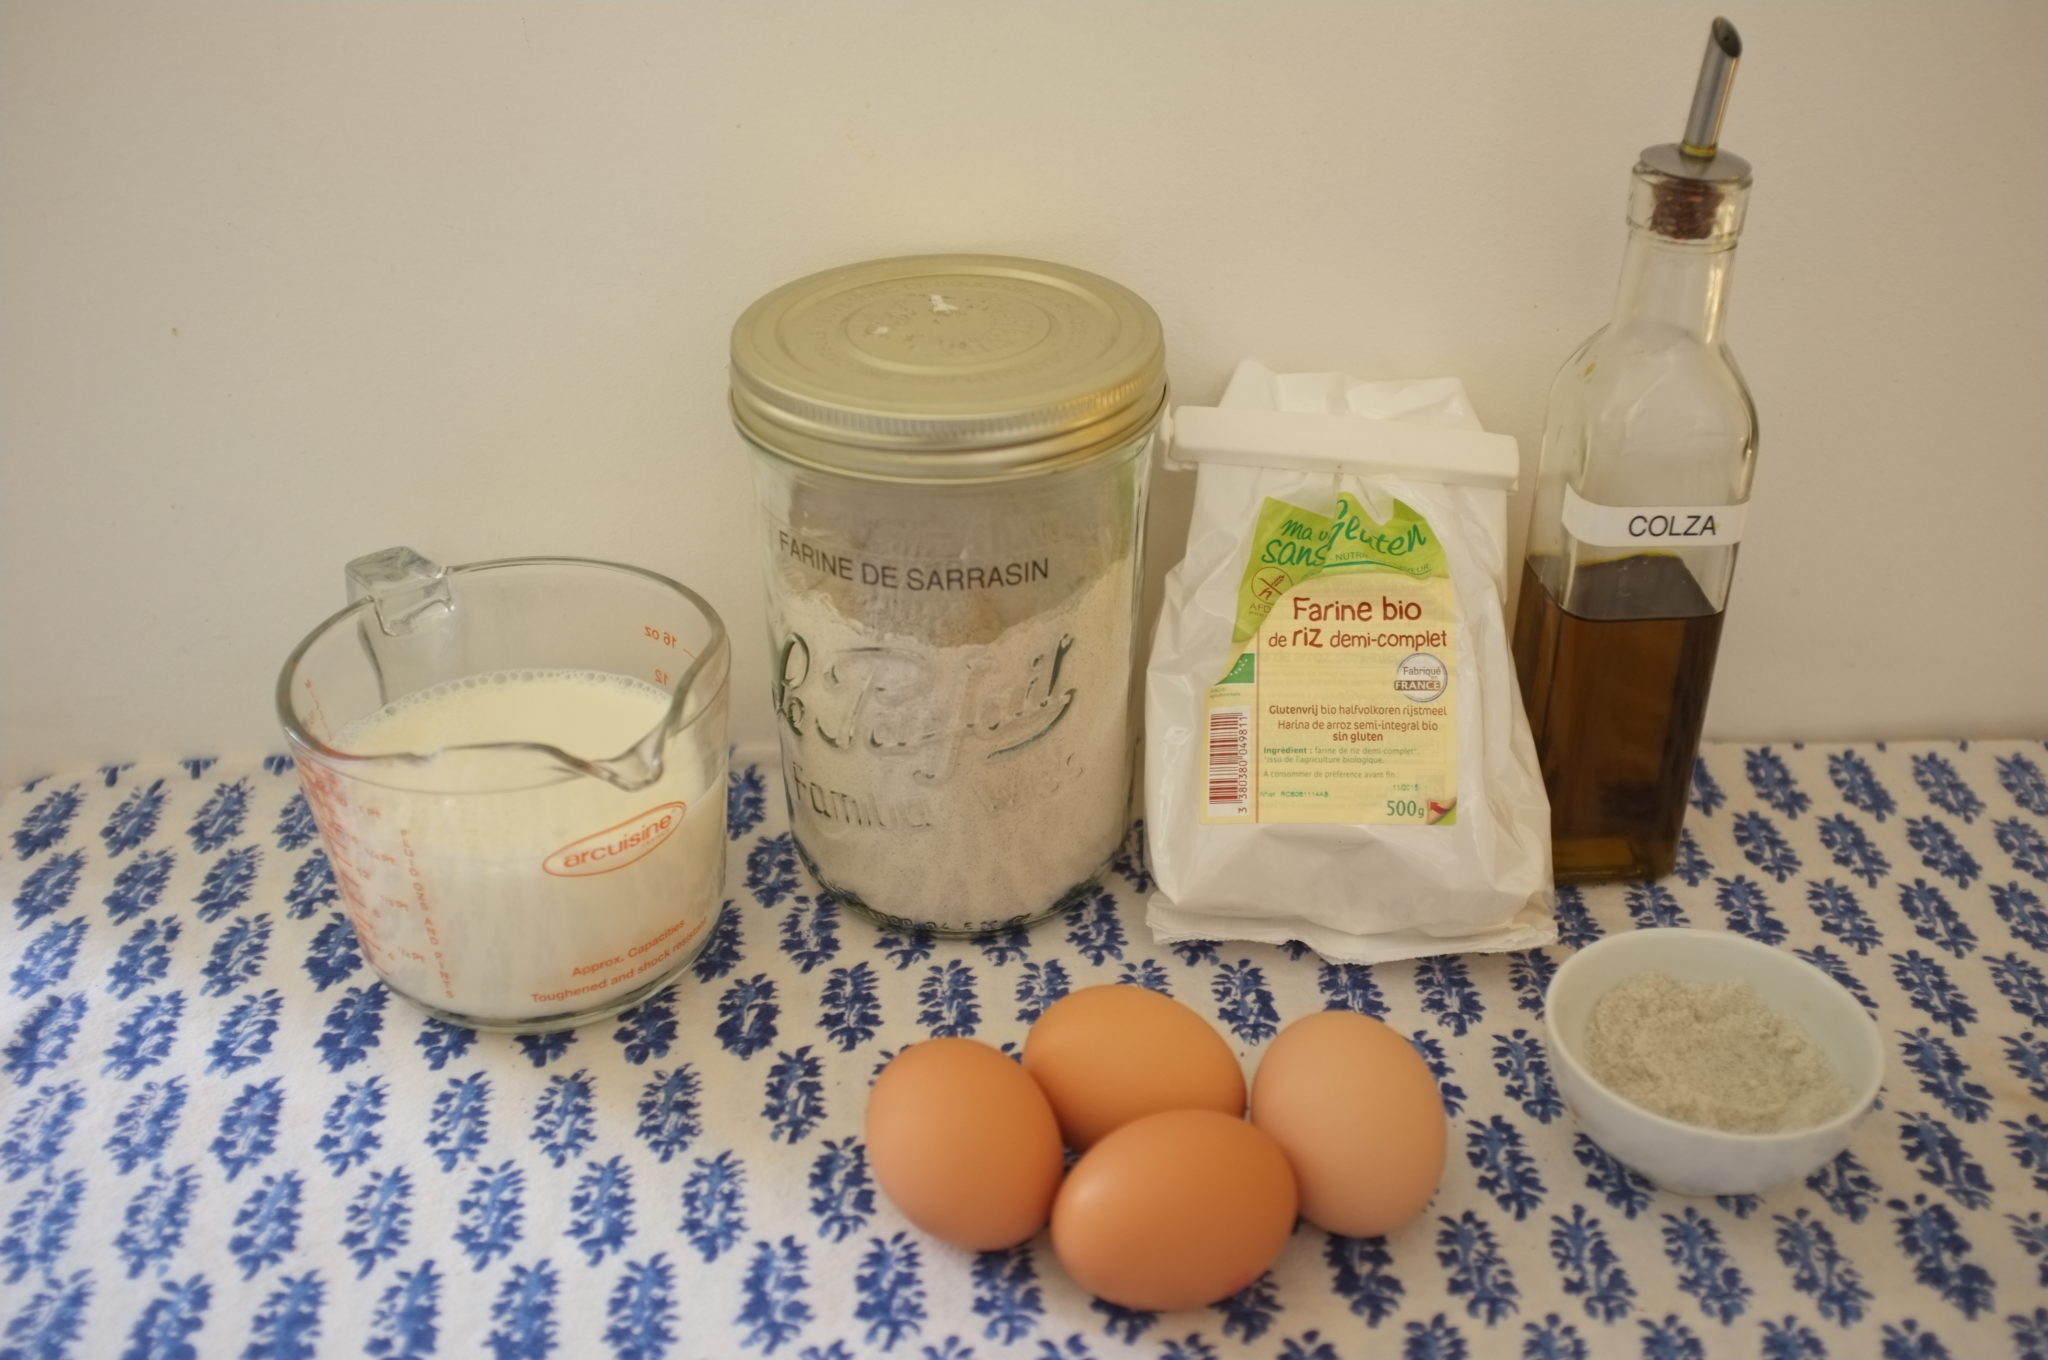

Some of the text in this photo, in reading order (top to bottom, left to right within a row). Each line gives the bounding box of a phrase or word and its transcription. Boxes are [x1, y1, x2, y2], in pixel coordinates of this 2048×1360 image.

[1281, 519, 1312, 541] ma
[1628, 515, 1717, 537] COLZA
[779, 530, 1049, 591] FARINE DE SARRASIN
[1261, 539, 1330, 567] sans
[1293, 596, 1422, 622] Farine bio
[1268, 627, 1447, 651] de riz demi-complet
[1403, 665, 1441, 681] Fabriqué
[1394, 681, 1441, 691] FRANCE
[1269, 705, 1447, 717] Glutenvrij bio halfvolkoren rijstmeel
[1238, 716, 1248, 755] 049811
[1278, 720, 1439, 732] Harina de arroz semi-integral bio
[1333, 732, 1384, 743] sin gluten
[1238, 760, 1248, 800] 380380
[563, 813, 673, 868] arcuisine
[572, 920, 685, 976] Approx. Capacities
[531, 980, 607, 1003] Toughened
[611, 970, 634, 985] and
[637, 950, 670, 973] shock
